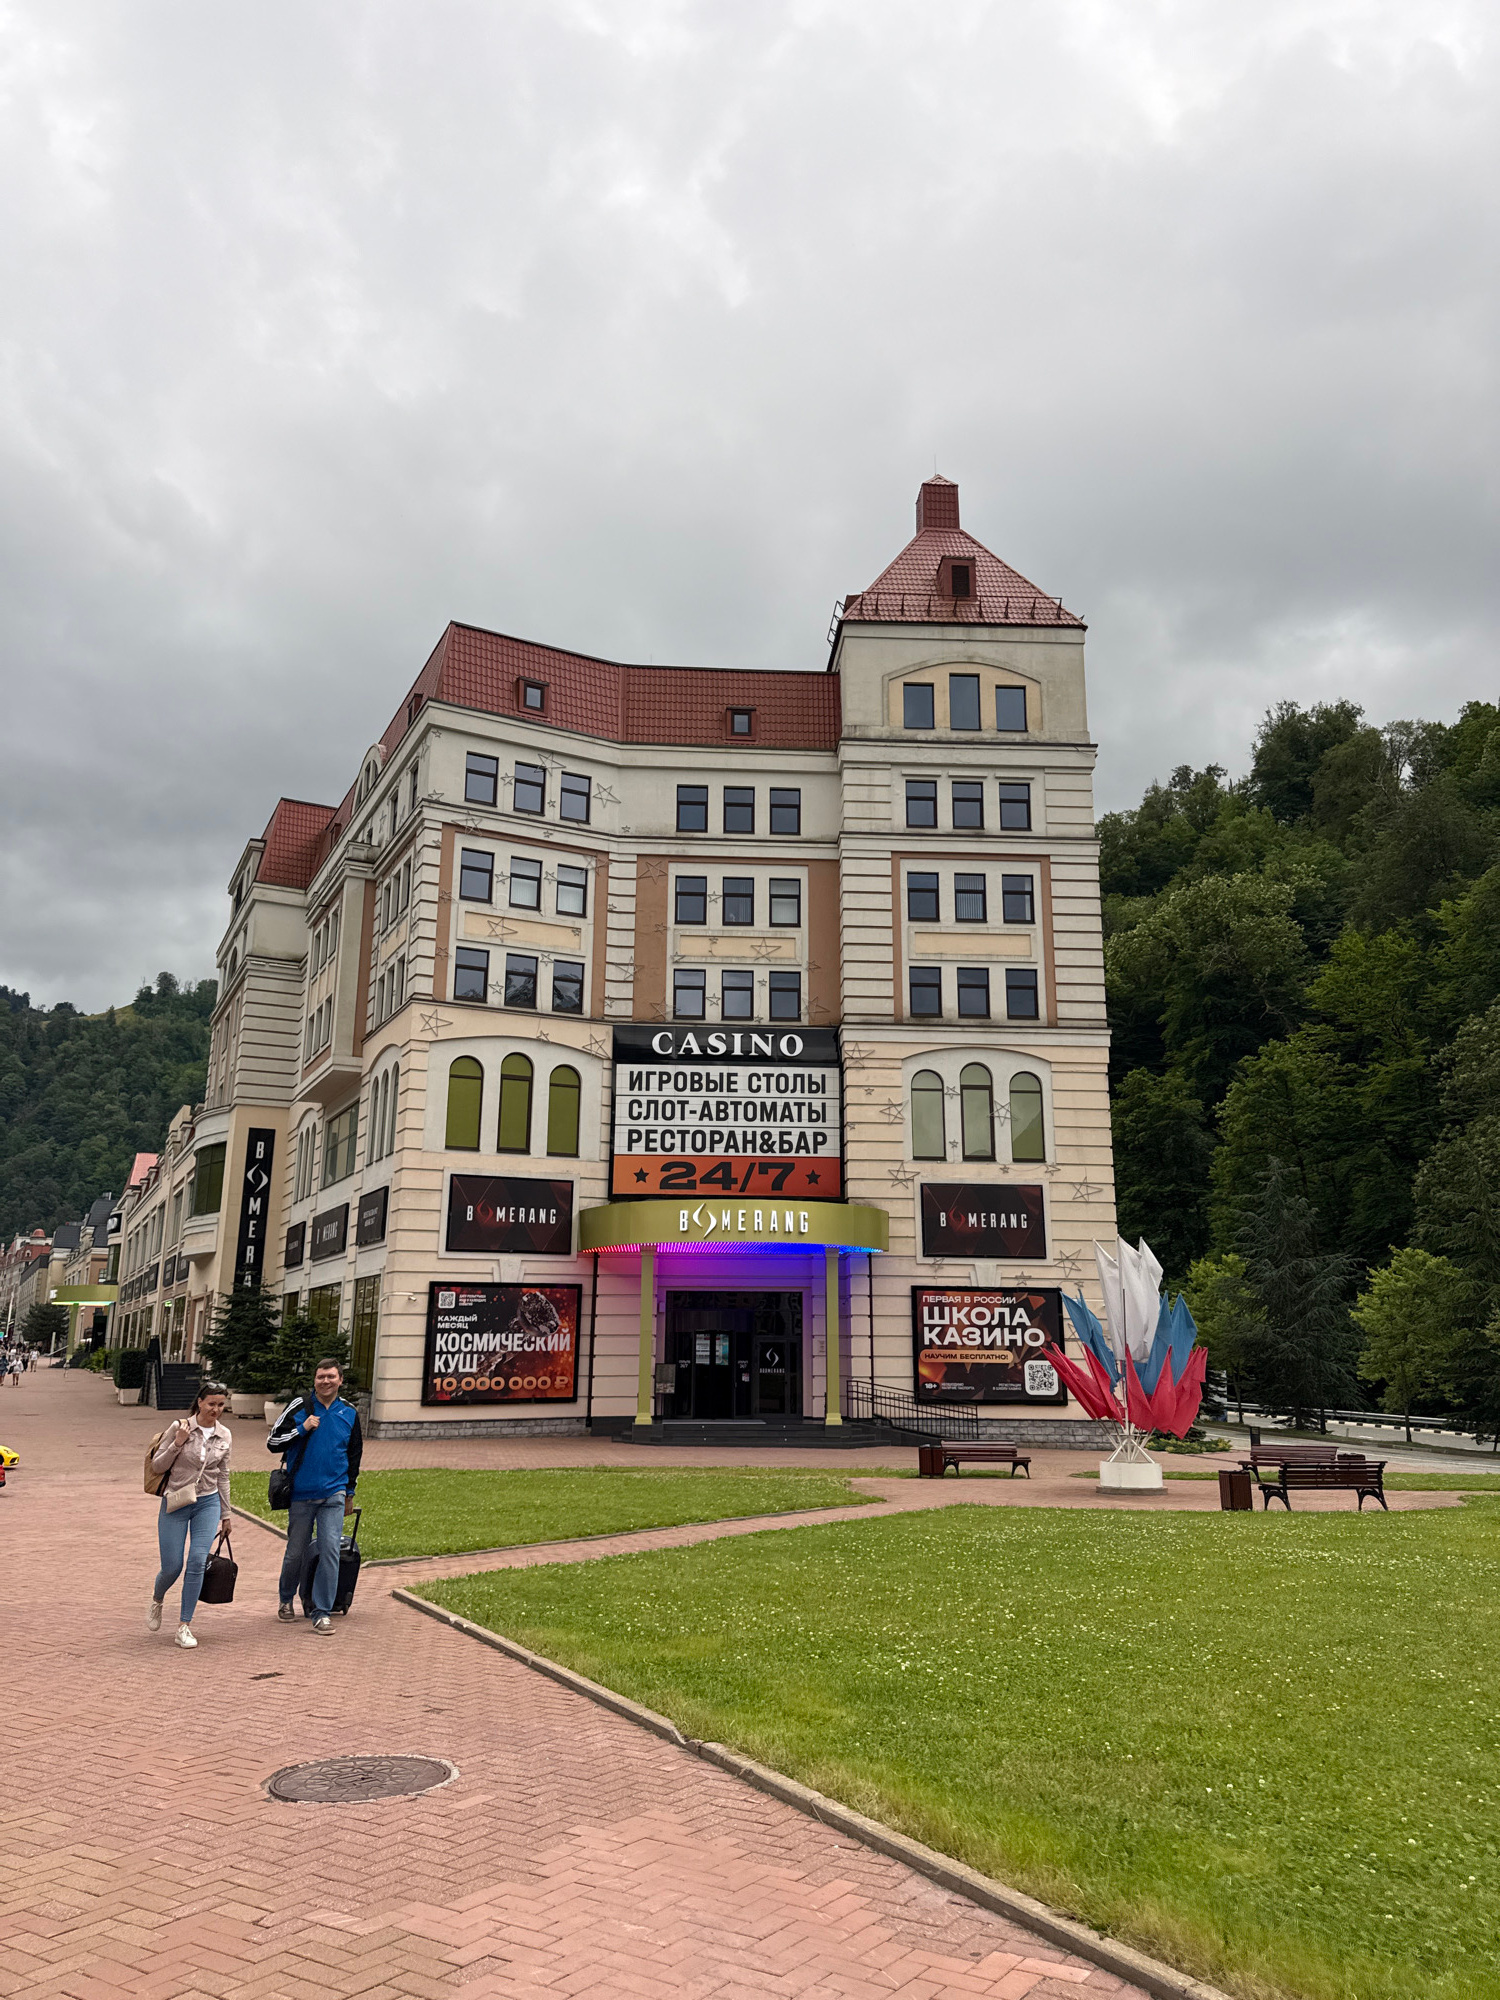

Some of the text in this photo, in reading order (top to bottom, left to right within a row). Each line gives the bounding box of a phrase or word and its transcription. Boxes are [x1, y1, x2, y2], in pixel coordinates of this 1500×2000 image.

[651, 1031, 804, 1057] CASINO
[628, 1070, 827, 1094] ИГРОВЫЕ СТОЛЫ
[627, 1099, 827, 1123] СЛОТ-АВТОМАТЫ
[627, 1129, 828, 1154] РЕСТОРАН&БАР
[659, 1161, 796, 1192] 24/7
[922, 1295, 962, 1304] ПЕРВАЯ
[973, 1296, 1016, 1304] РОССИИ
[437, 1314, 478, 1323] КАЖДЫЙ
[437, 1322, 469, 1330] МЕСЯЦ
[922, 1306, 1031, 1326] ШКОЛА
[436, 1328, 570, 1352] КОСМИЧЕСКИЙ
[923, 1327, 1045, 1347] КАЗИНО
[434, 1354, 478, 1373] КУШ
[960, 1353, 1009, 1361] БЕСПЛАТНО!
[433, 1377, 458, 1392] 10
[460, 1376, 506, 1391] 000
[508, 1376, 552, 1390] 000
[924, 1382, 938, 1390] 18+
